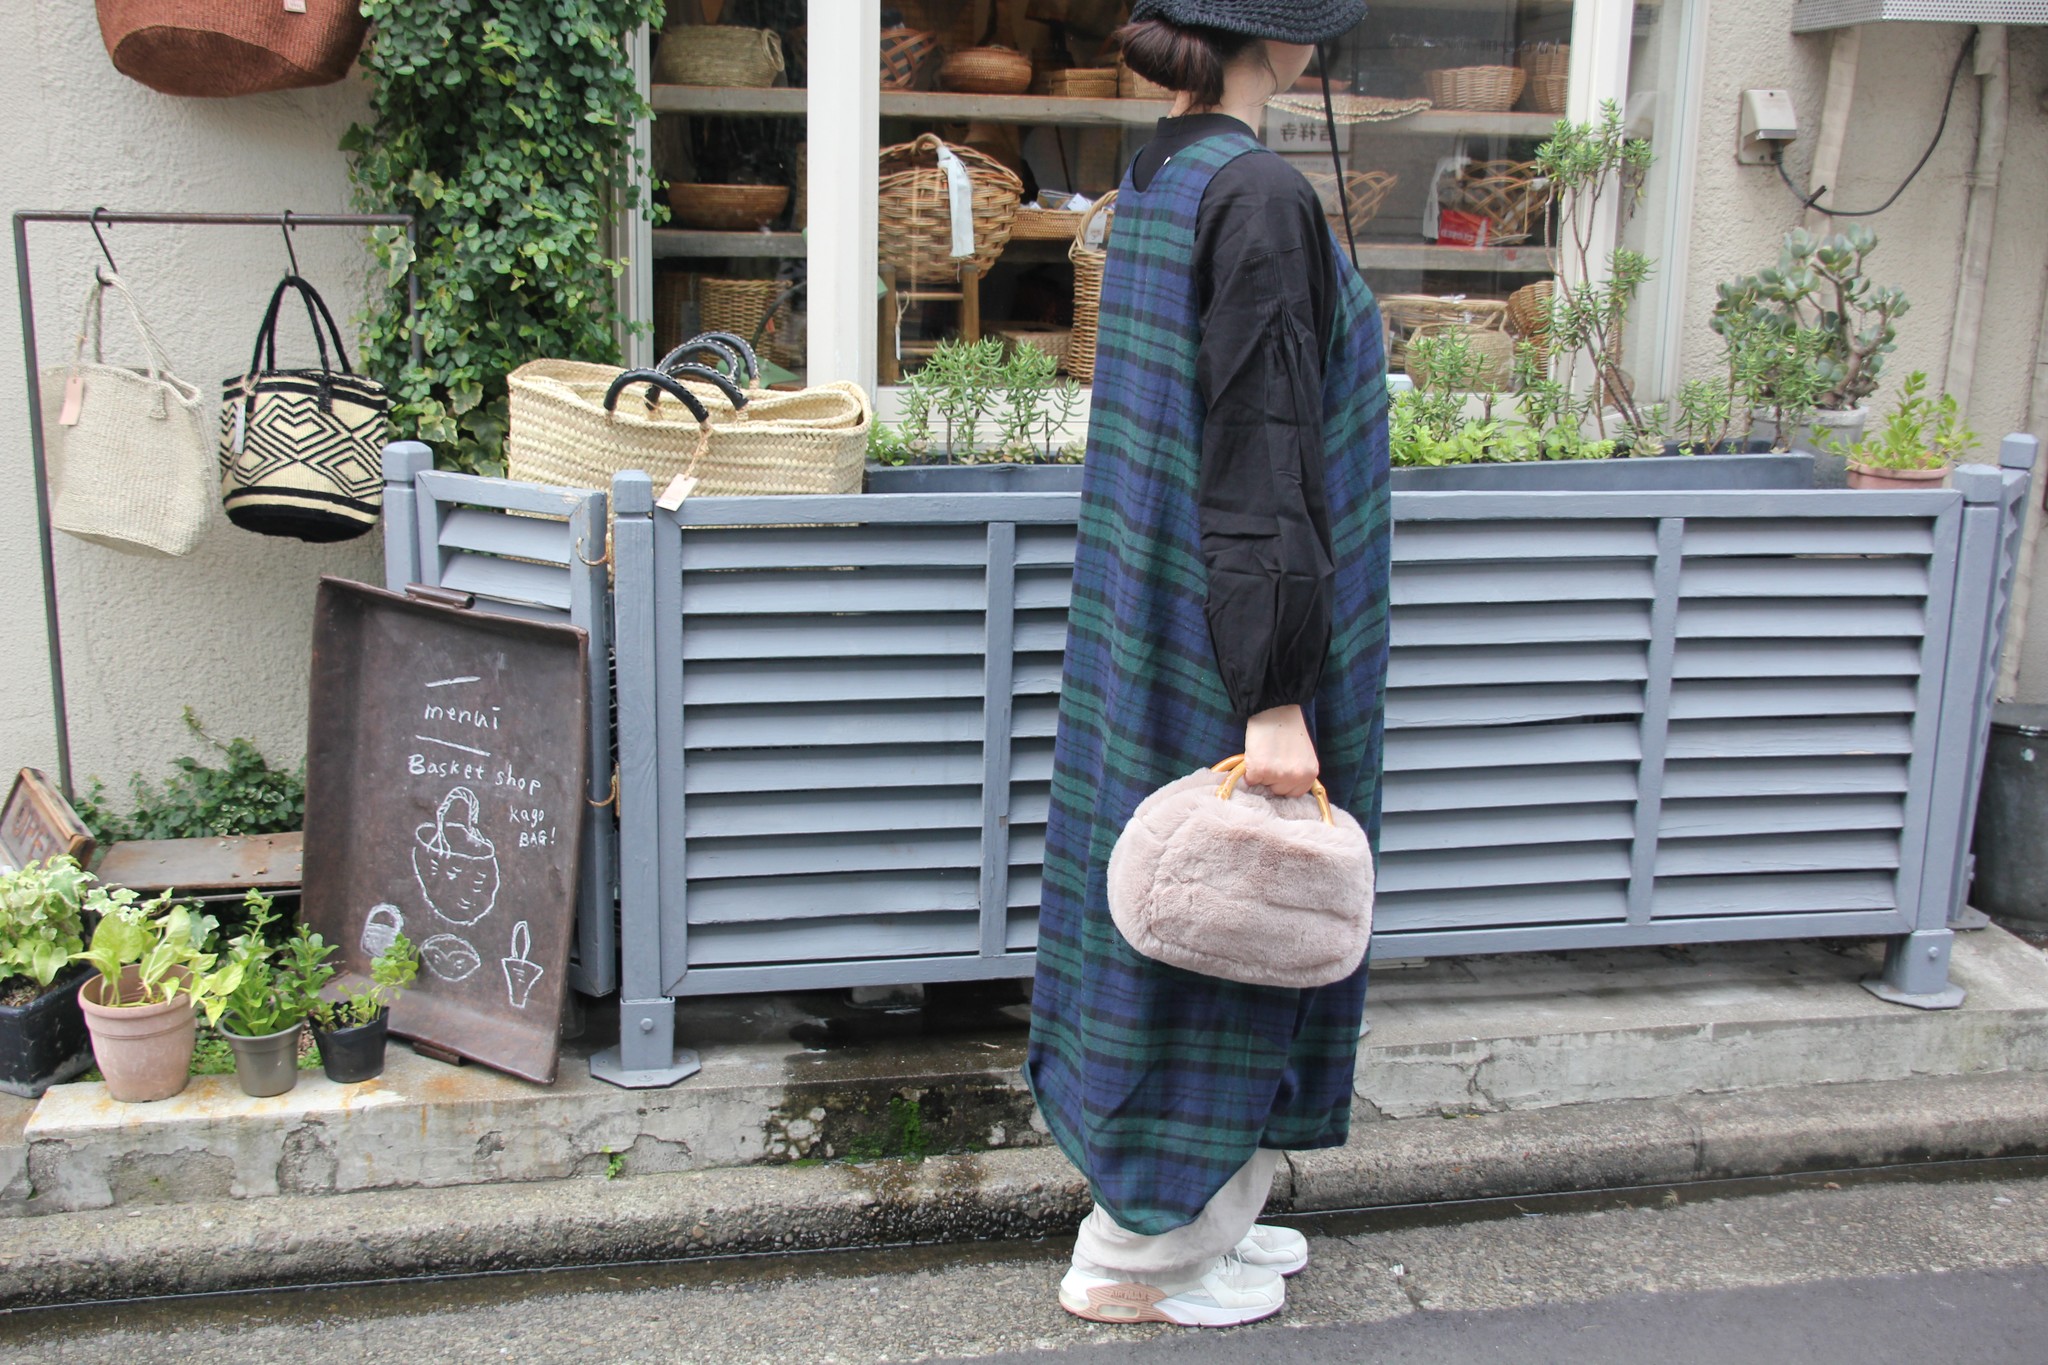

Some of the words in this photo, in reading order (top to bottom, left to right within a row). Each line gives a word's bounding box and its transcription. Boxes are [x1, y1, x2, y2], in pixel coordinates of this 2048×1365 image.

[408, 753, 485, 780] Basket
[495, 764, 541, 795] shop
[519, 826, 556, 848] BAG!
